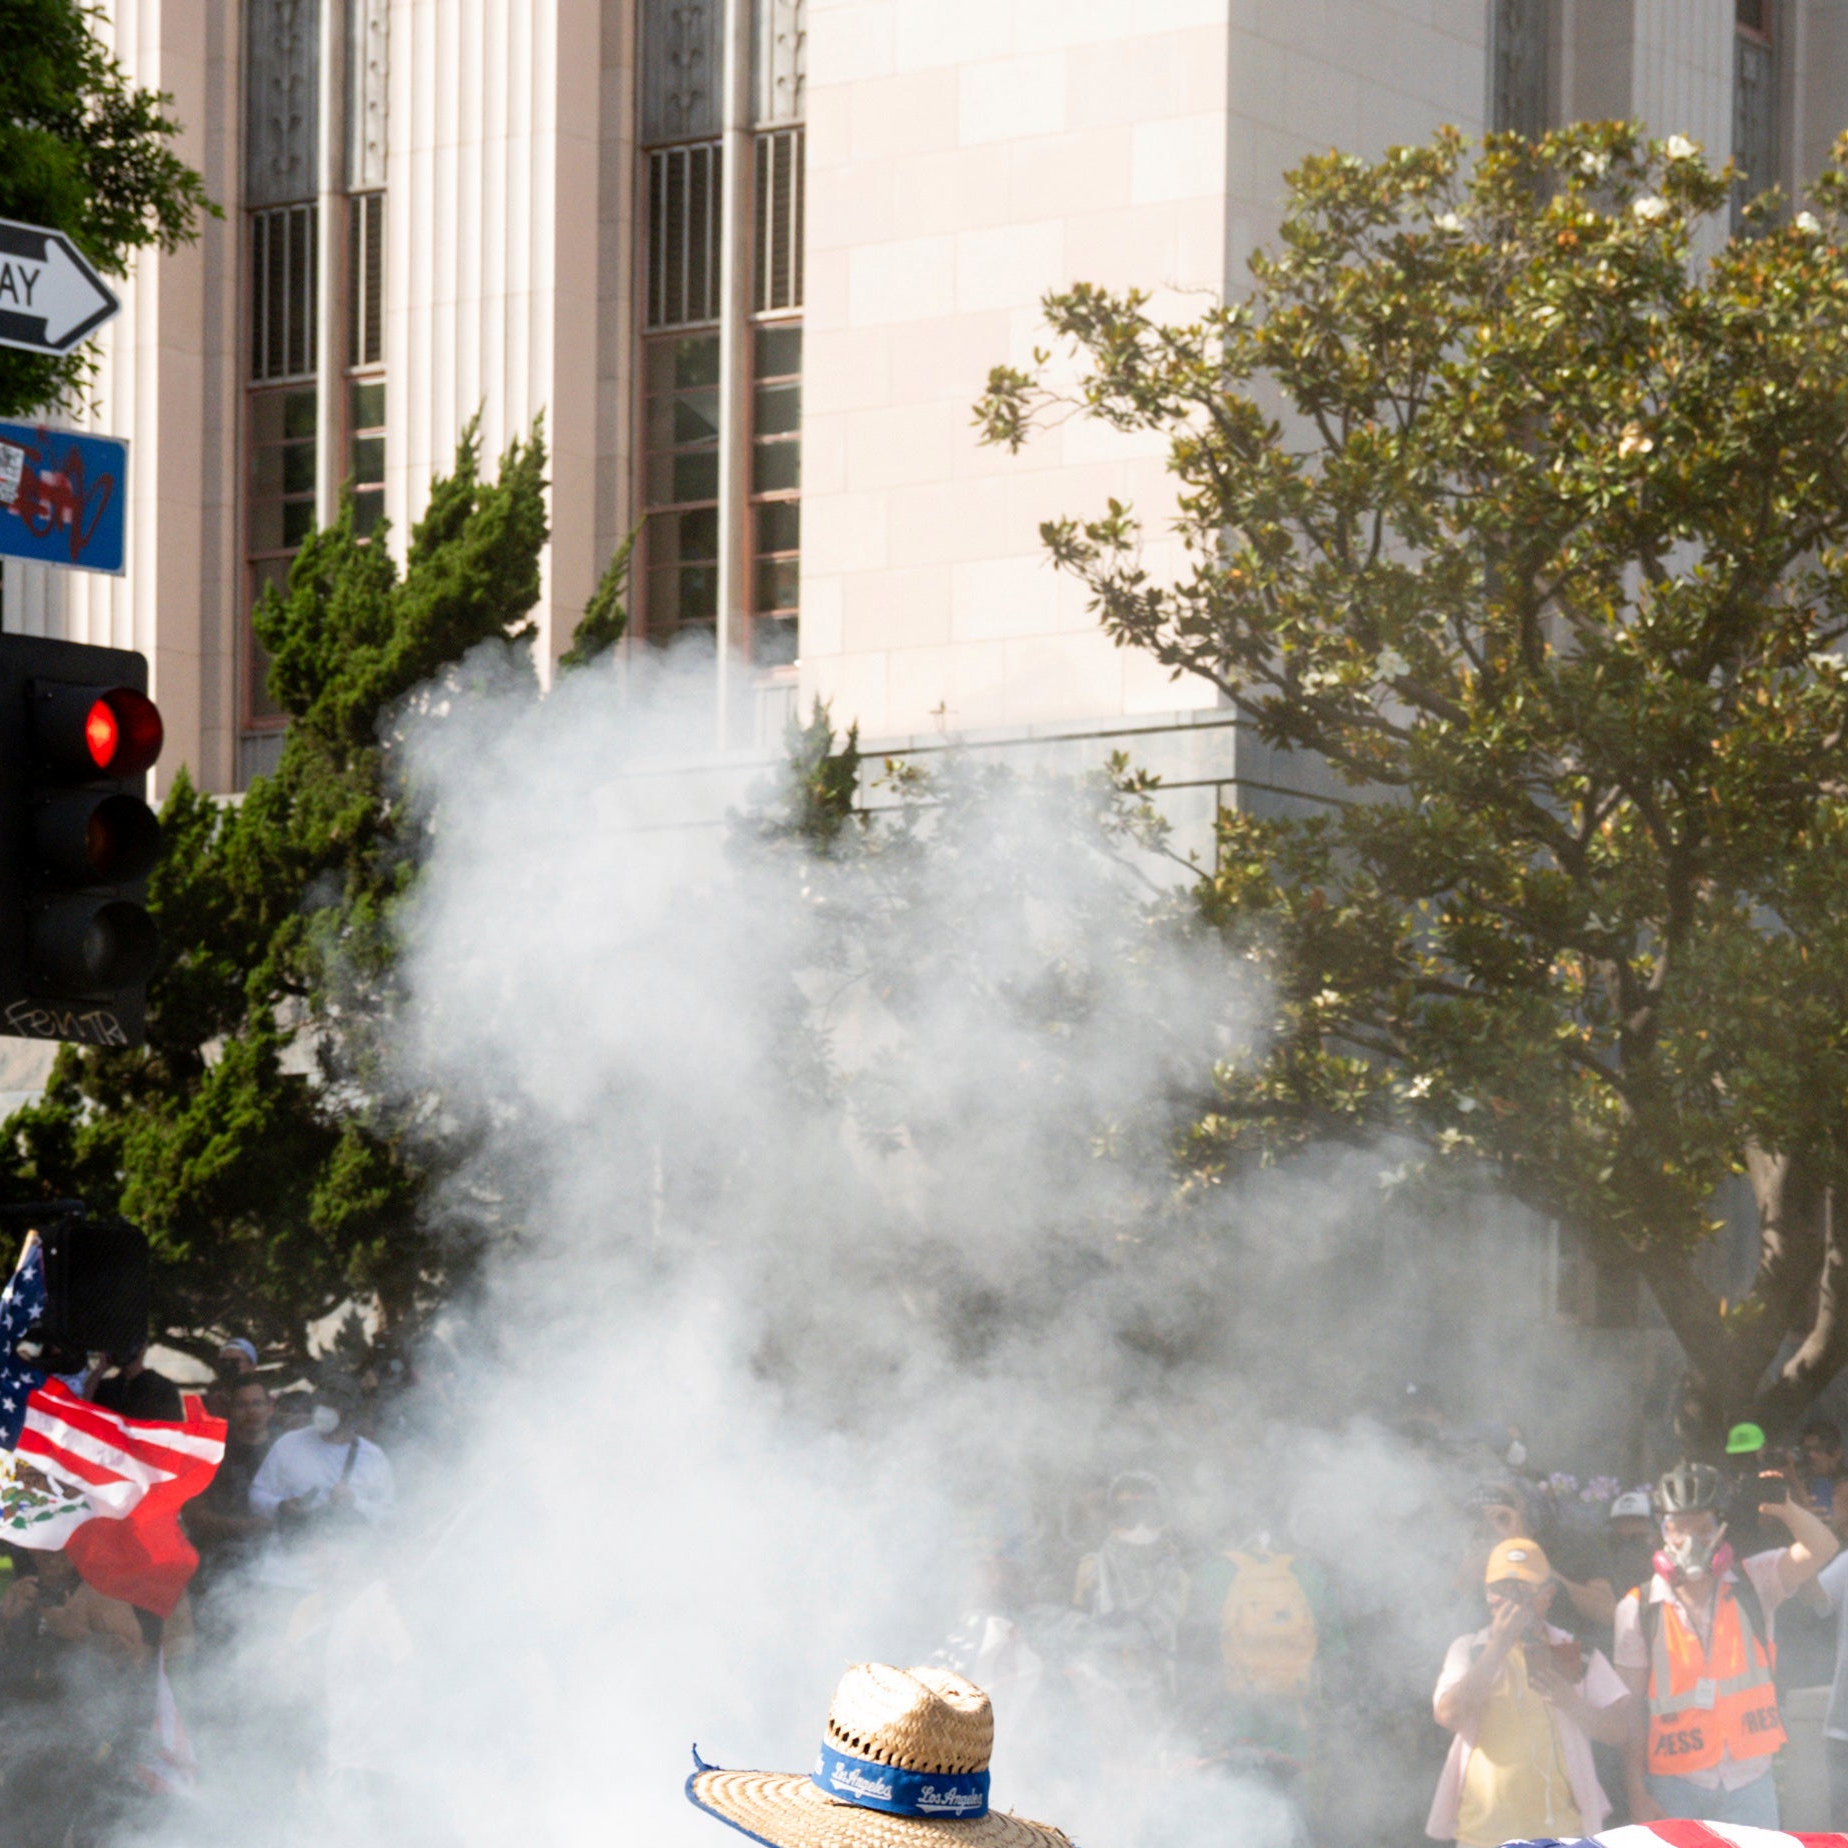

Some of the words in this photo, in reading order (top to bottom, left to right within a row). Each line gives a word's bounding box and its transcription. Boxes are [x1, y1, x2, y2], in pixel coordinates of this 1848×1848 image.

[832, 1761, 849, 1782] Los
[847, 1768, 892, 1799] Angeles
[917, 1786, 940, 1804] Los
[942, 1787, 984, 1816] Angeles
